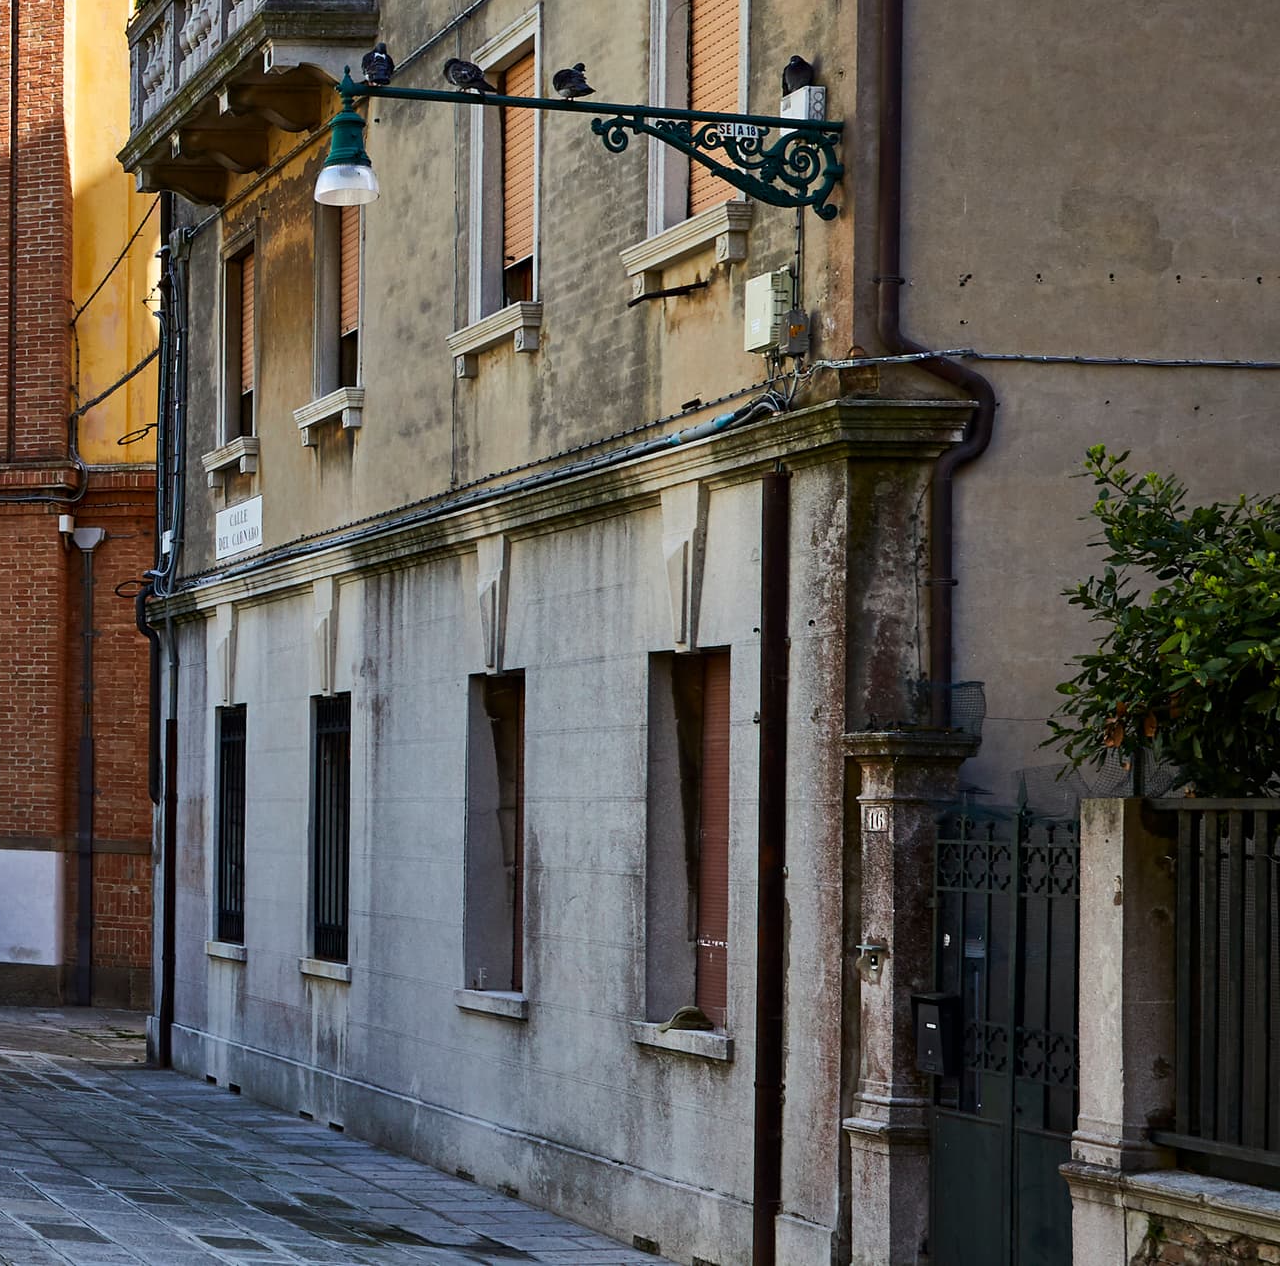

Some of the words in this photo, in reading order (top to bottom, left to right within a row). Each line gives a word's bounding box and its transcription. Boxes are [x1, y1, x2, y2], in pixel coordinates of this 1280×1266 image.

[719, 124, 732, 135] SE
[746, 125, 756, 136] 18
[229, 509, 248, 526] CALLE
[218, 535, 229, 551] DEL
